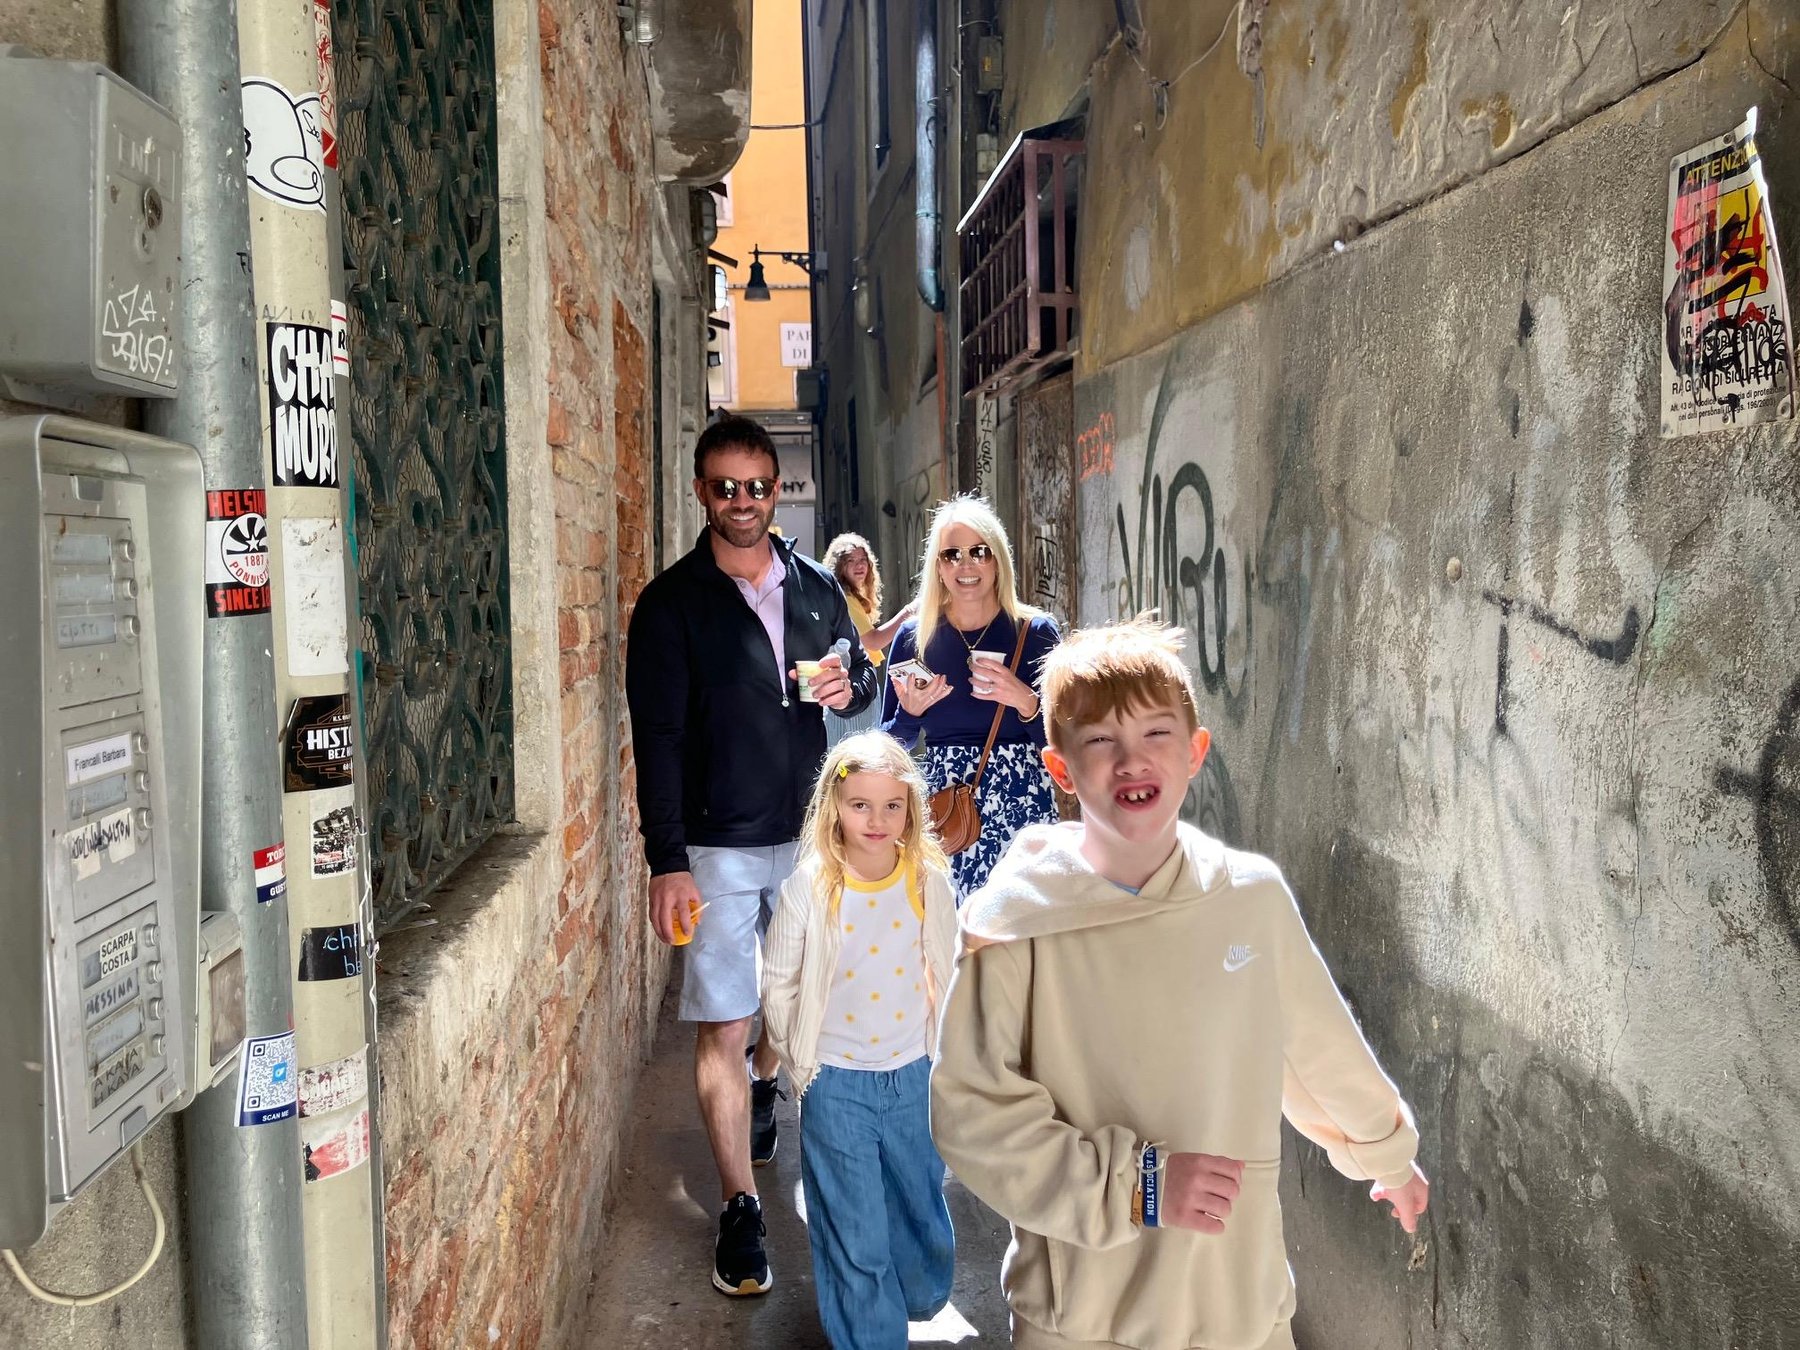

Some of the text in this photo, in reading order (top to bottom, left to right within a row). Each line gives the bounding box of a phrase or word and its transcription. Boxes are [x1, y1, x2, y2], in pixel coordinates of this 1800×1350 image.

[793, 348, 807, 359] DI
[1746, 390, 1752, 398] di
[1753, 385, 1786, 398] protezione
[215, 588, 260, 612] SINCE
[102, 748, 127, 764] Barbara
[328, 747, 346, 760] BEZ
[101, 930, 135, 958] SCARPA
[1228, 944, 1250, 961] NIKE
[102, 950, 130, 975] COSTA
[262, 1109, 289, 1122] SCAN ME
